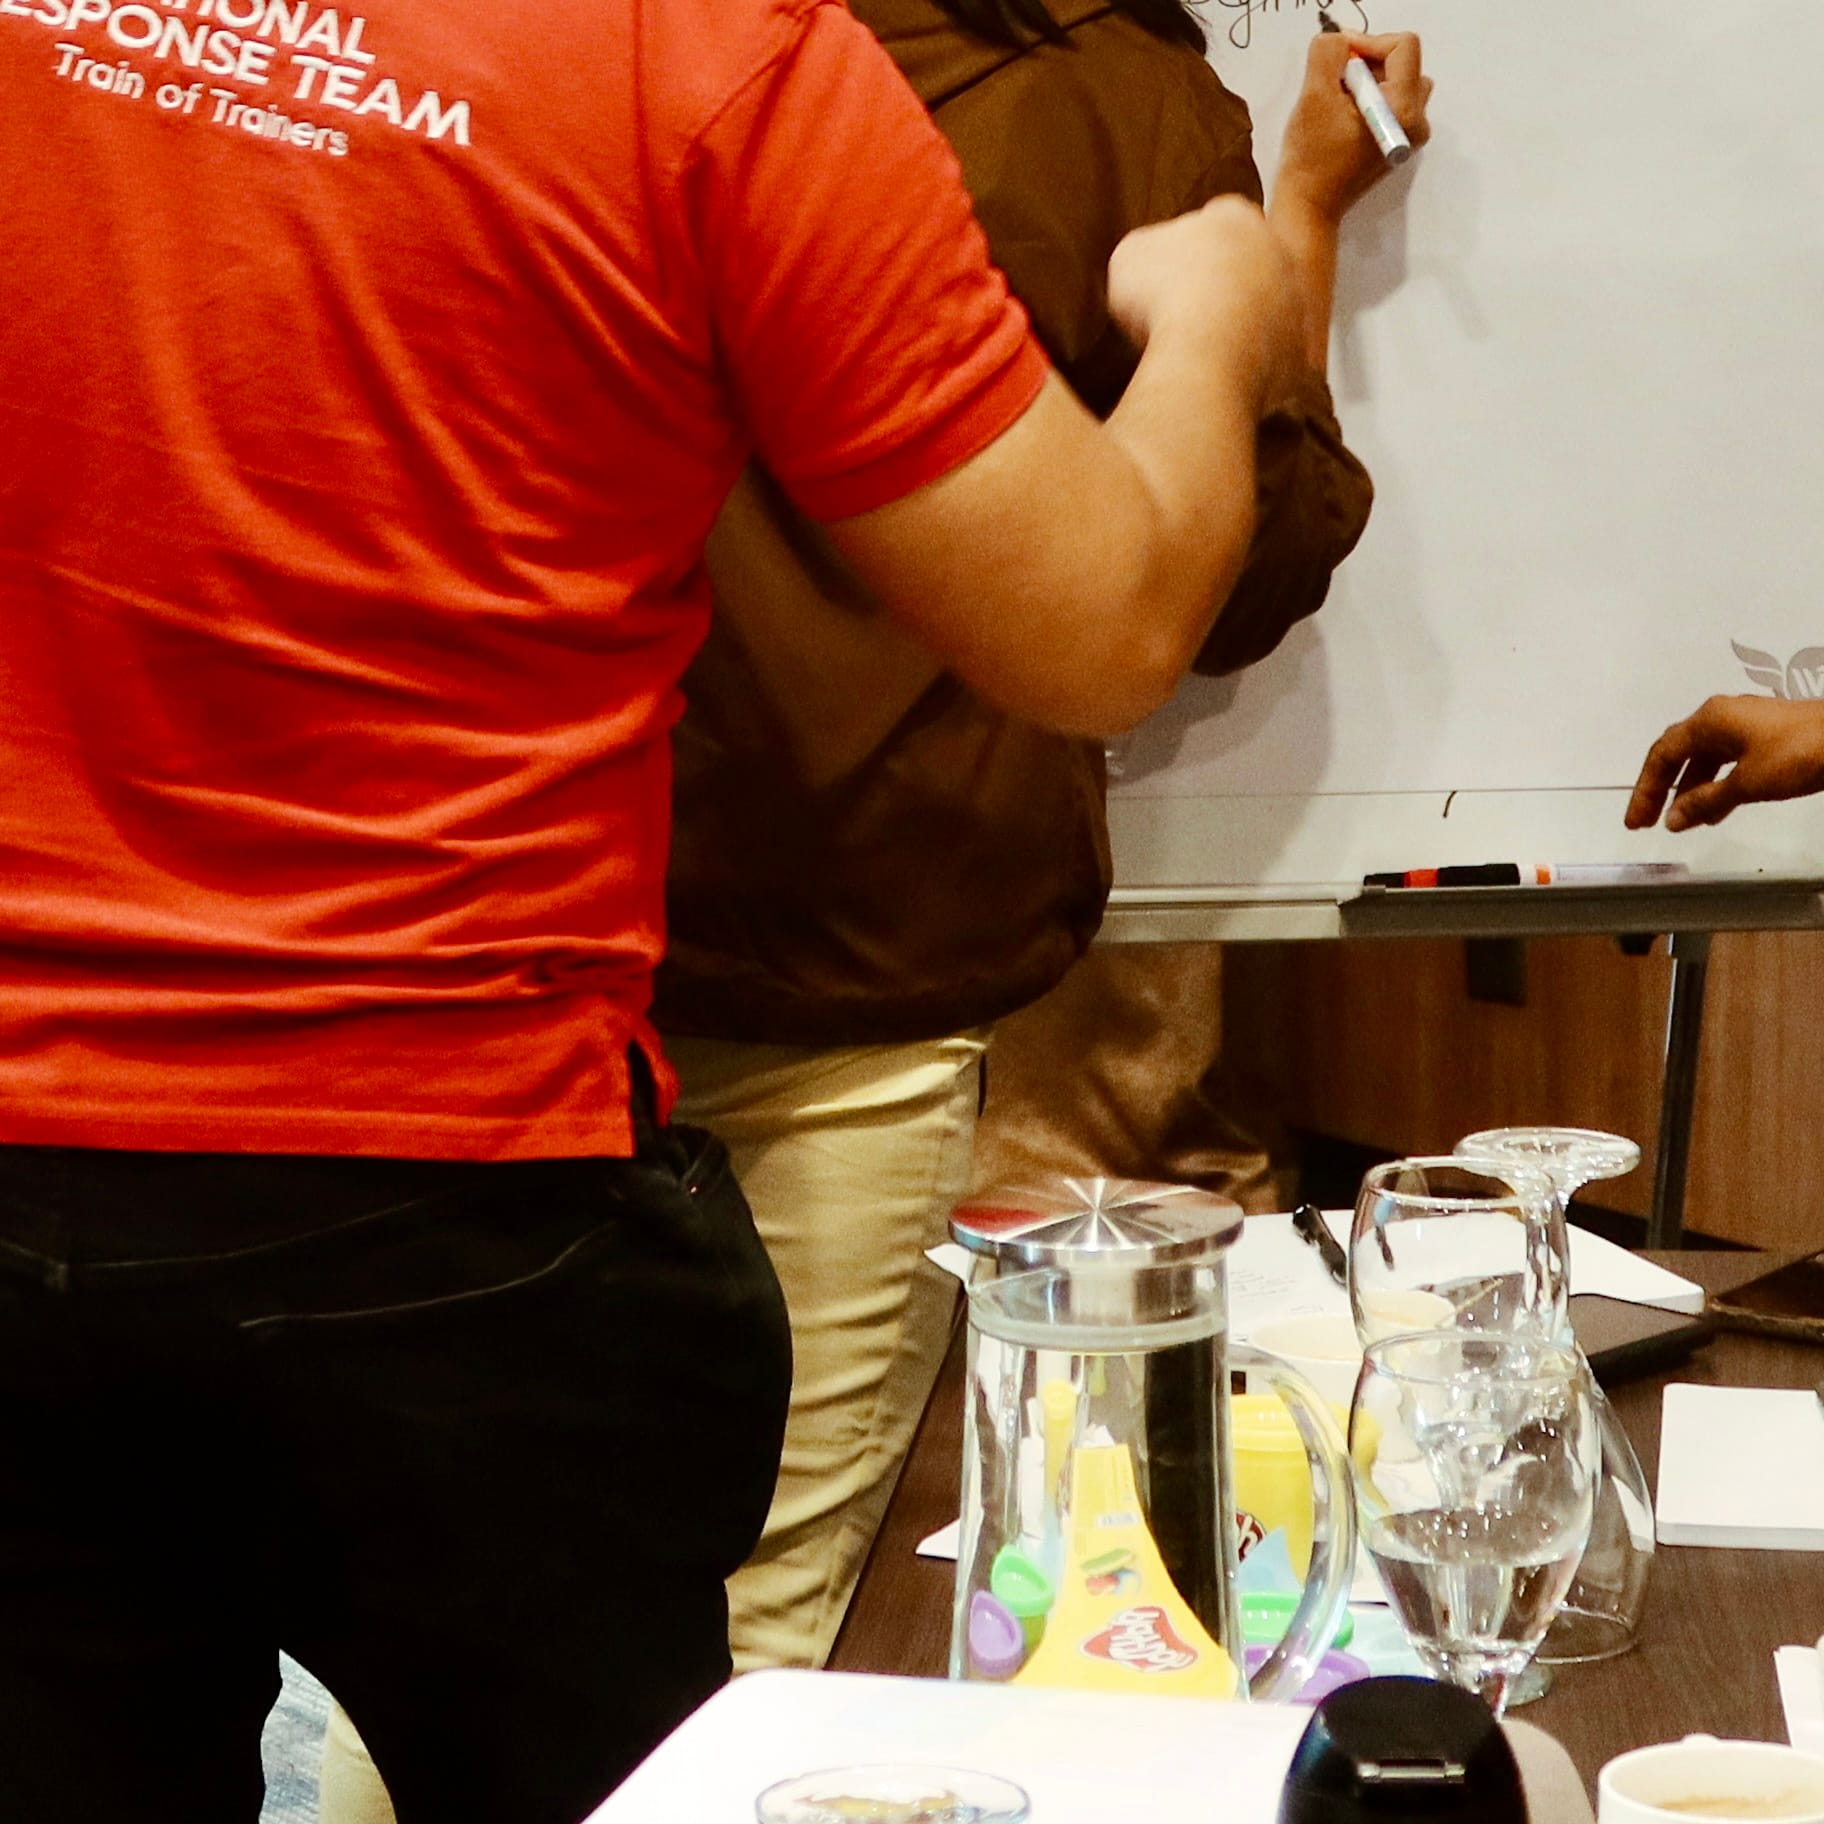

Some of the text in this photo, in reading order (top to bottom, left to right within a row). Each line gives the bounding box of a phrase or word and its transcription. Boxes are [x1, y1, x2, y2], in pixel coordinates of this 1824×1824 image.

[54, 42, 349, 156] Train of Trainers
[290, 54, 471, 146] TEAM
